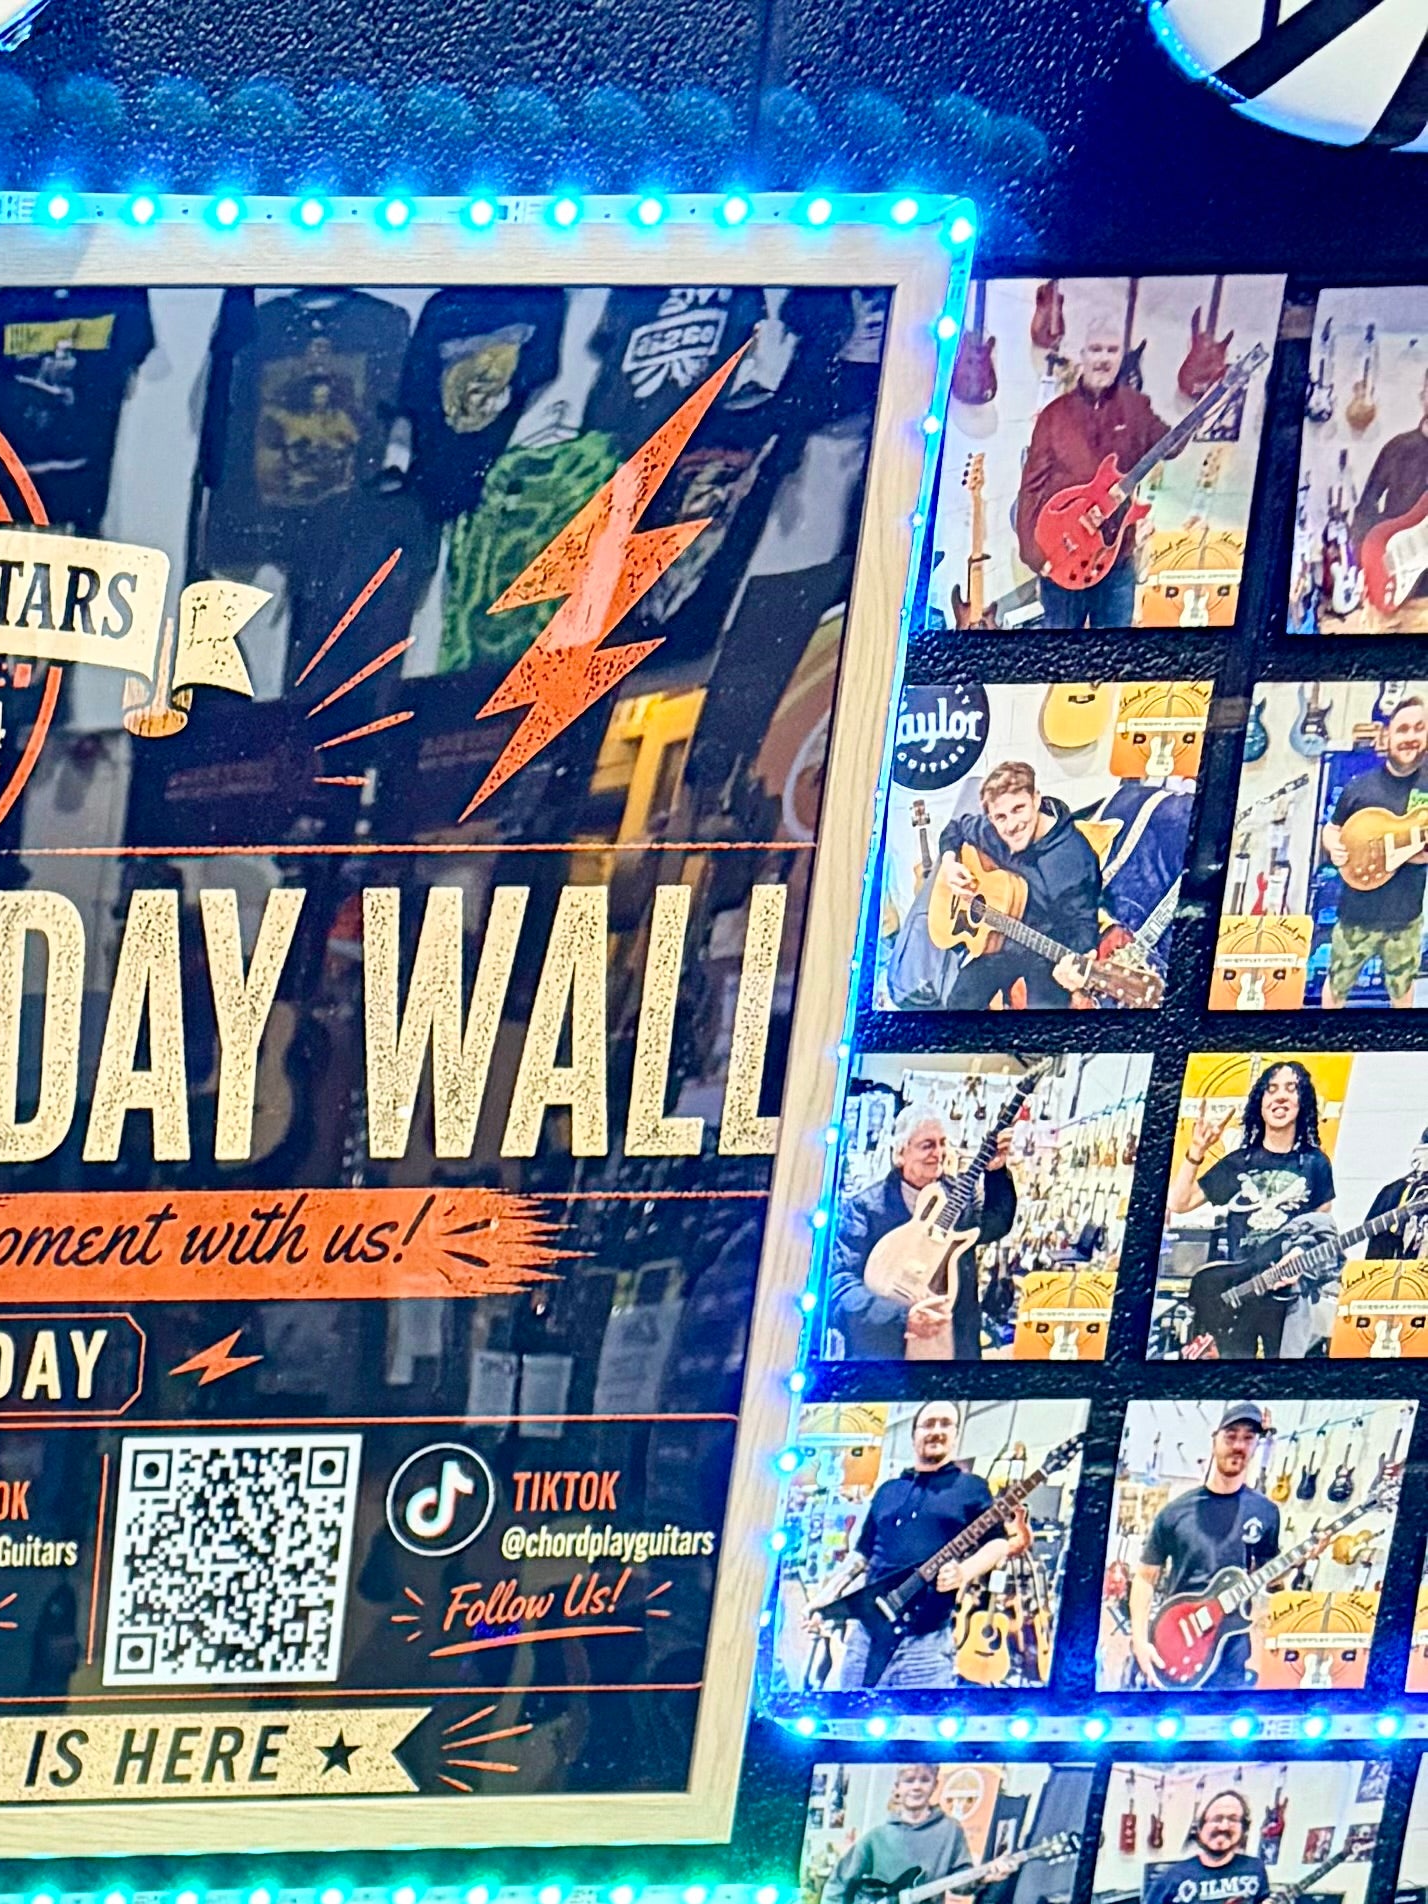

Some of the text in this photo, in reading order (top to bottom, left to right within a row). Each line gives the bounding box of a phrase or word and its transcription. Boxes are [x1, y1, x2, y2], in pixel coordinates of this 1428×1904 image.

[895, 697, 985, 754] aylor
[362, 883, 788, 1161] WALL
[182, 1195, 310, 1270] with
[322, 1193, 430, 1264] us!
[511, 1471, 619, 1515] TIKTOK
[500, 1523, 716, 1564] @chordplayguitars
[442, 1569, 628, 1633] Follow Us!
[25, 1729, 90, 1787] IS
[113, 1722, 292, 1786] HERE
